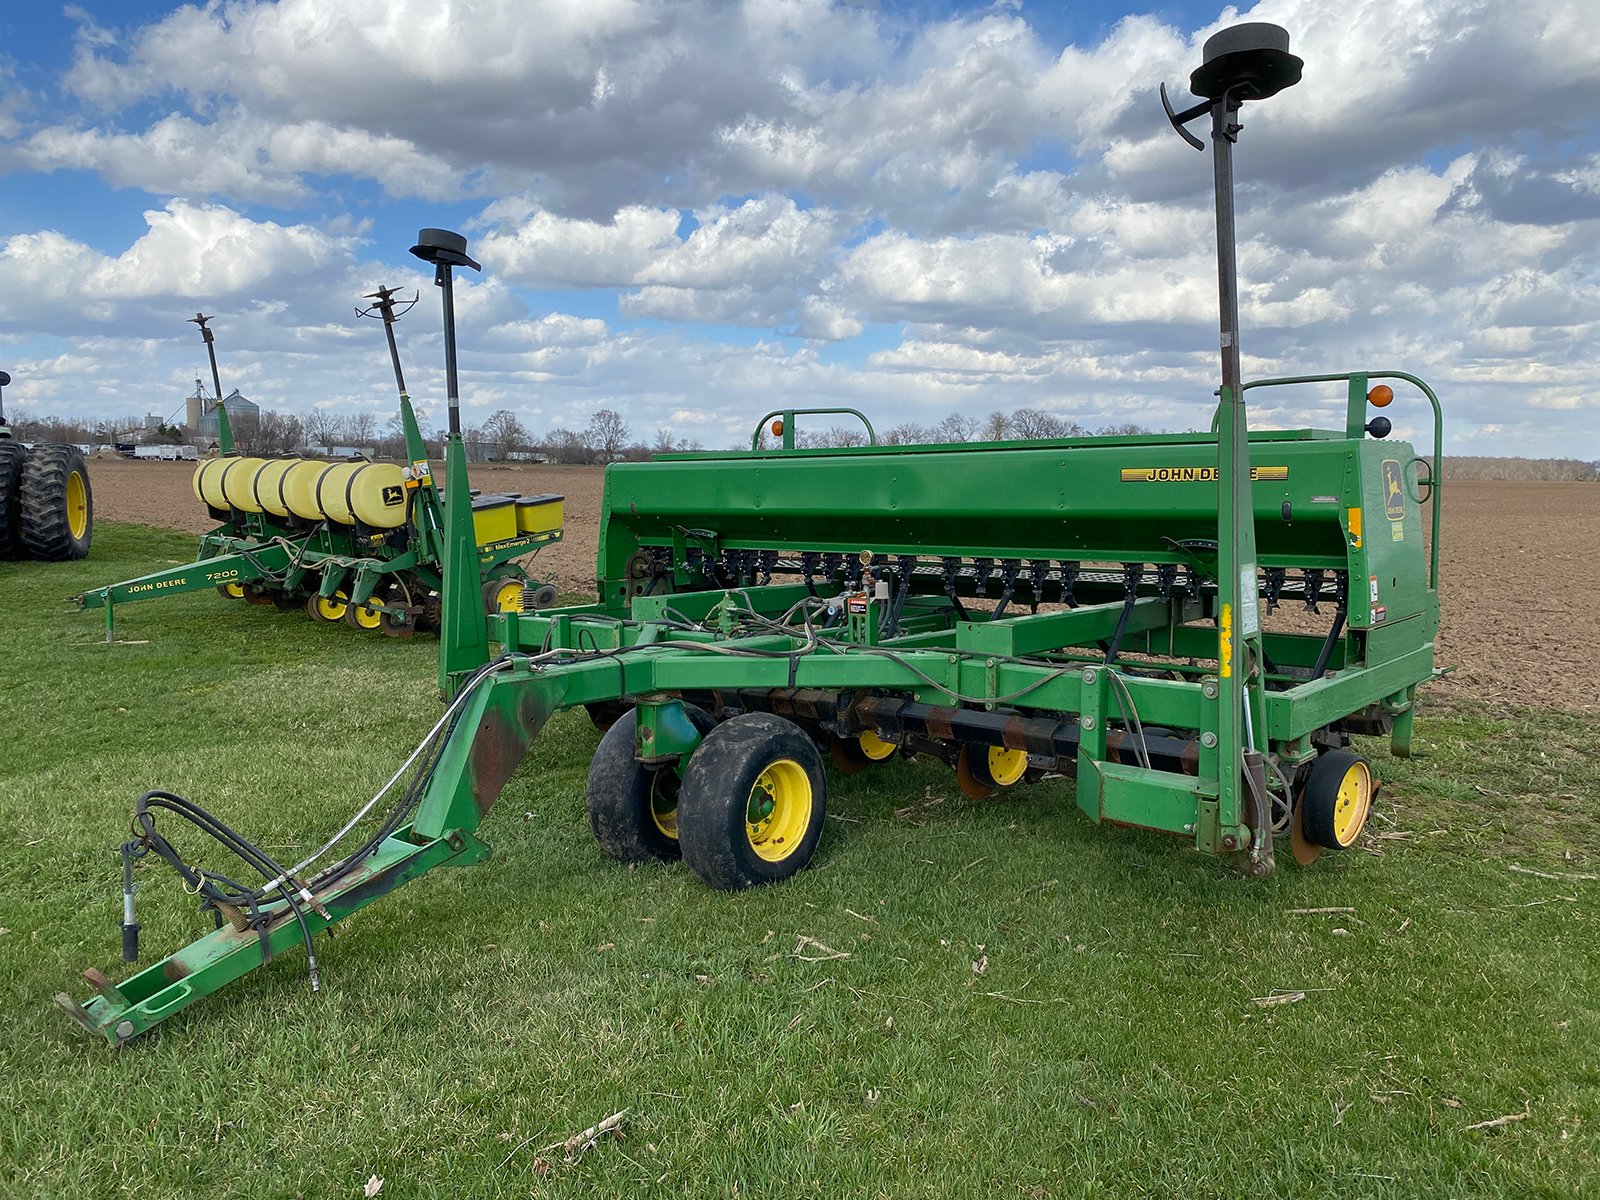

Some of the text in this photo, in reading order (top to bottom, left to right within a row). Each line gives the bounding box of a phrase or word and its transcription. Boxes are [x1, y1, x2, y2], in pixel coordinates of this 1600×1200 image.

[1148, 468, 1257, 480] JOHN DEE
[206, 570, 238, 580] 7200
[128, 578, 186, 593] JOHN DEERE
